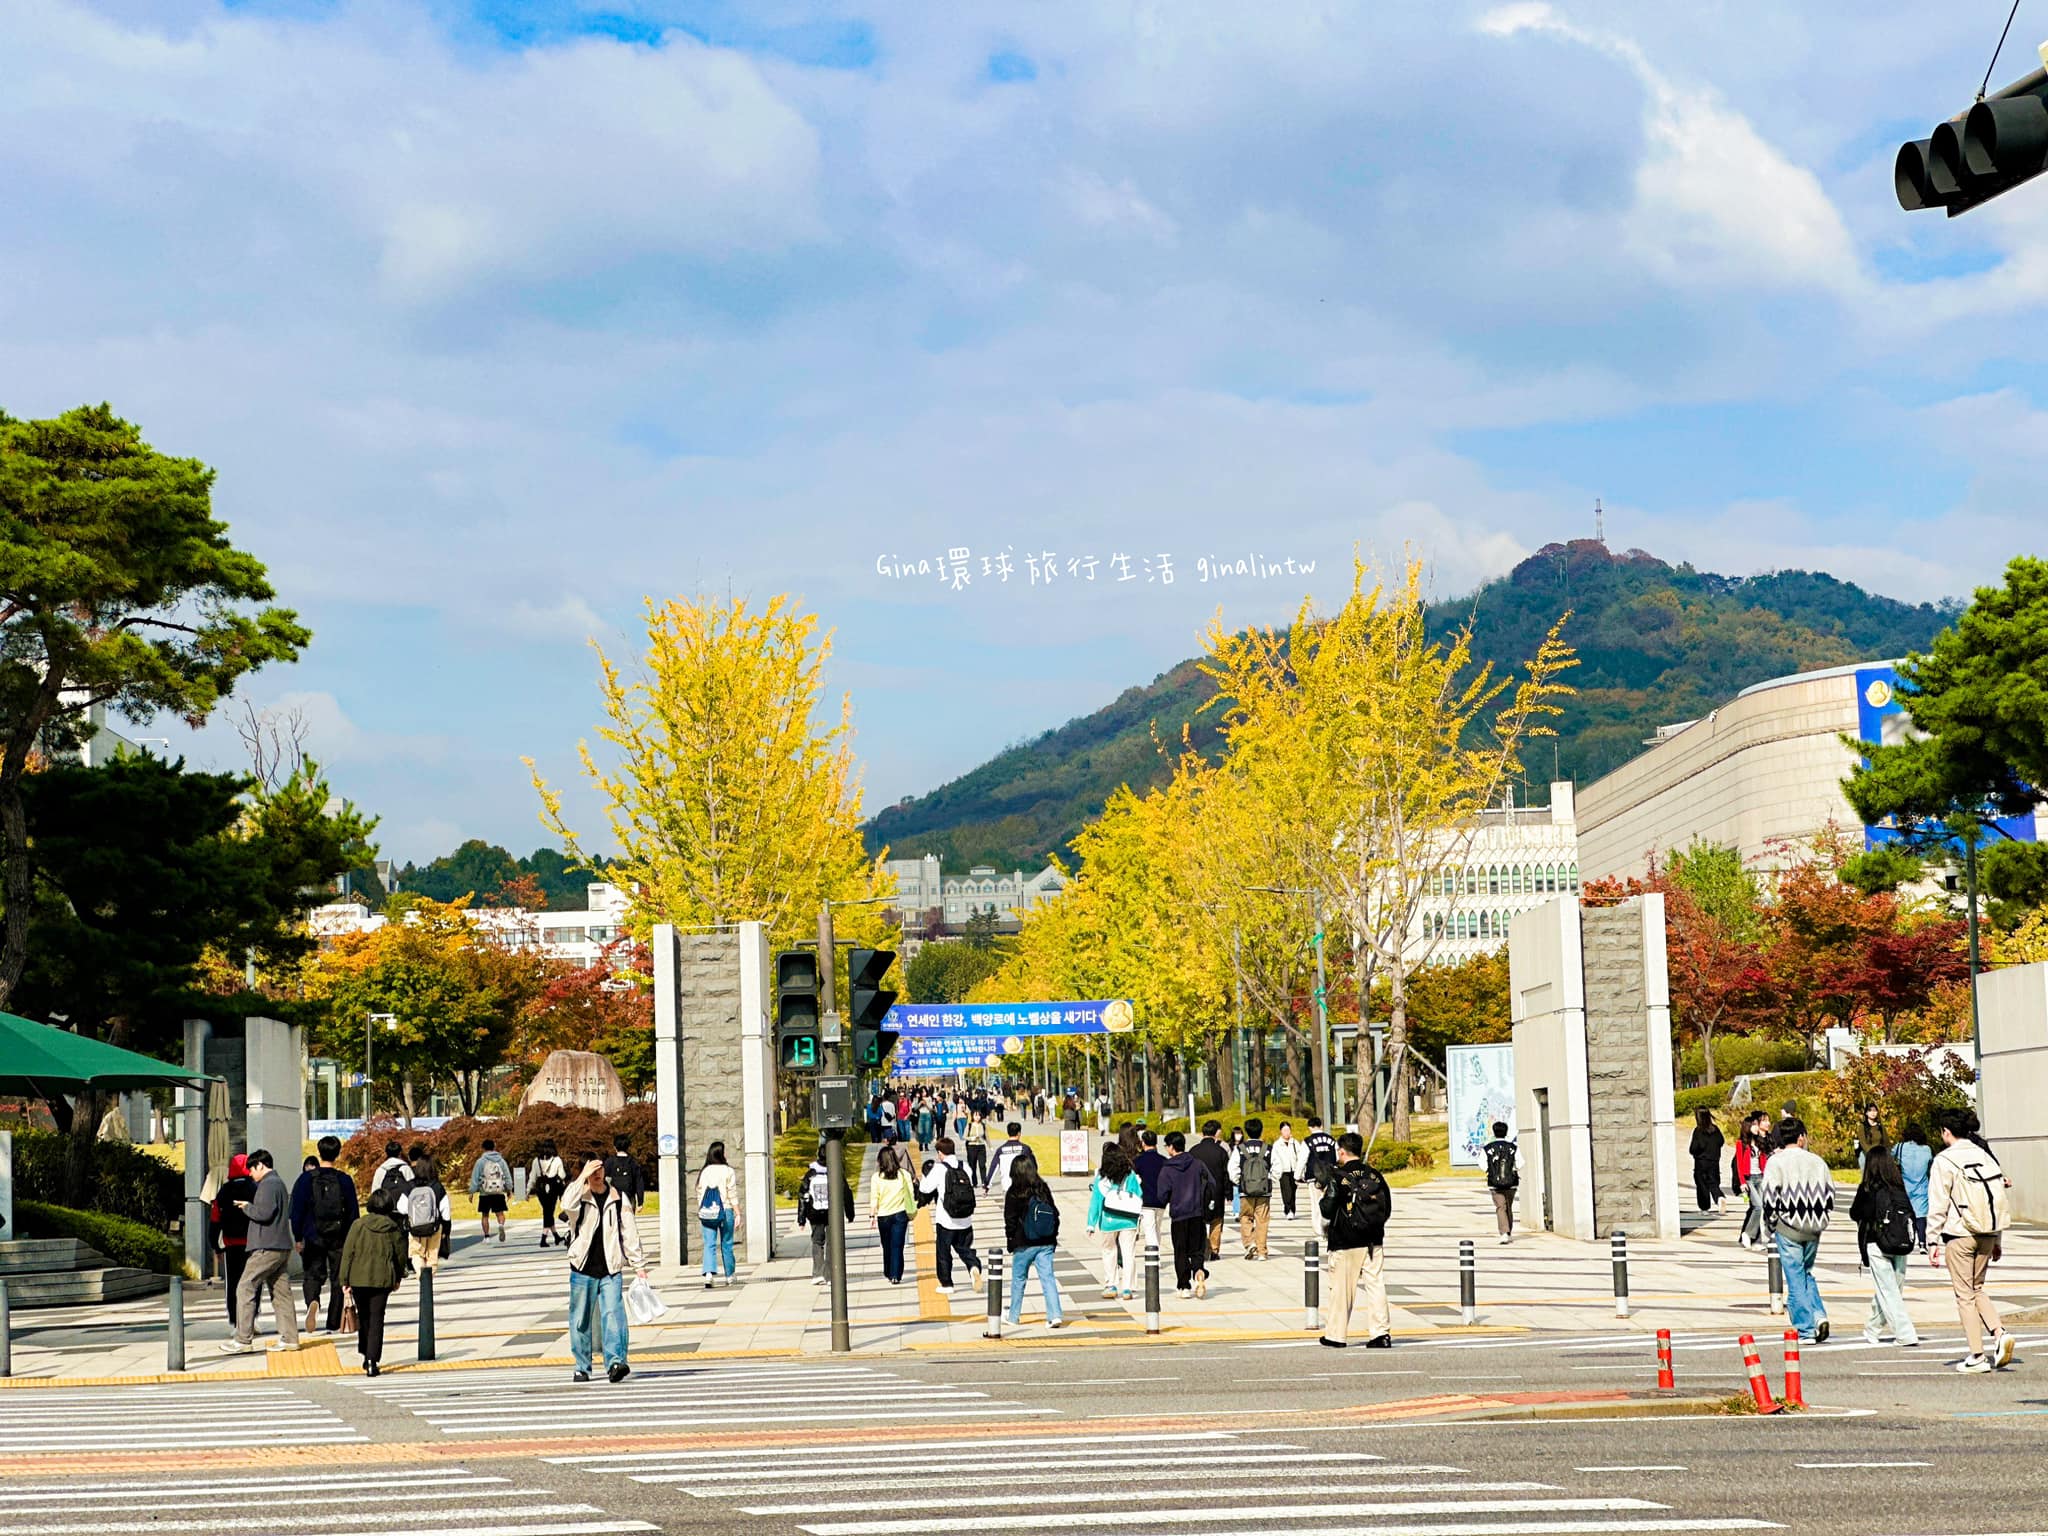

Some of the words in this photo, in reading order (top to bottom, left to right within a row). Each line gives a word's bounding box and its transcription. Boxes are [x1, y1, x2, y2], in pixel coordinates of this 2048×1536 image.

[907, 1013, 940, 1028] 연세인
[942, 1013, 967, 1029] 한강,
[1017, 1011, 1061, 1026] 노벨상을
[1064, 1010, 1097, 1024] 새기다
[794, 1037, 815, 1065] 13
